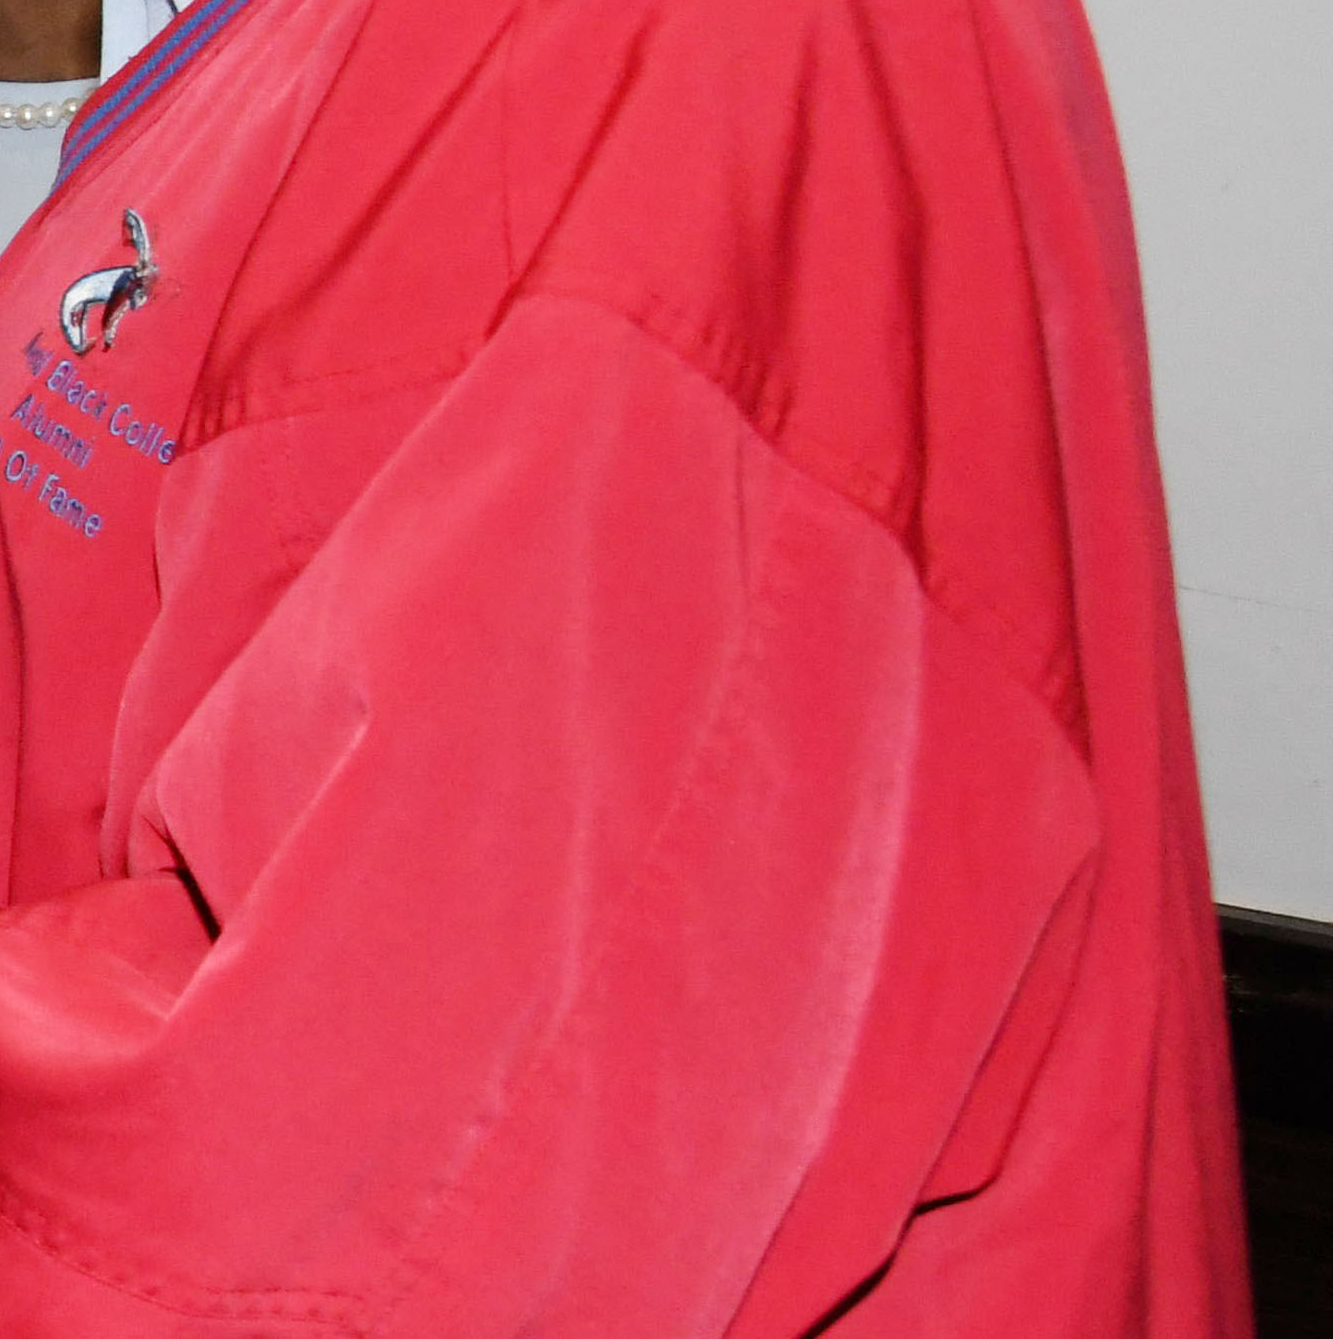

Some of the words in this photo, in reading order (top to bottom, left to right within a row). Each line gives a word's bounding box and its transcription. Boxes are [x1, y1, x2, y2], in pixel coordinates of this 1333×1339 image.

[45, 359, 107, 421] Black
[10, 394, 95, 468] Alumni
[4, 450, 39, 490] Of
[38, 473, 102, 537] Fame
